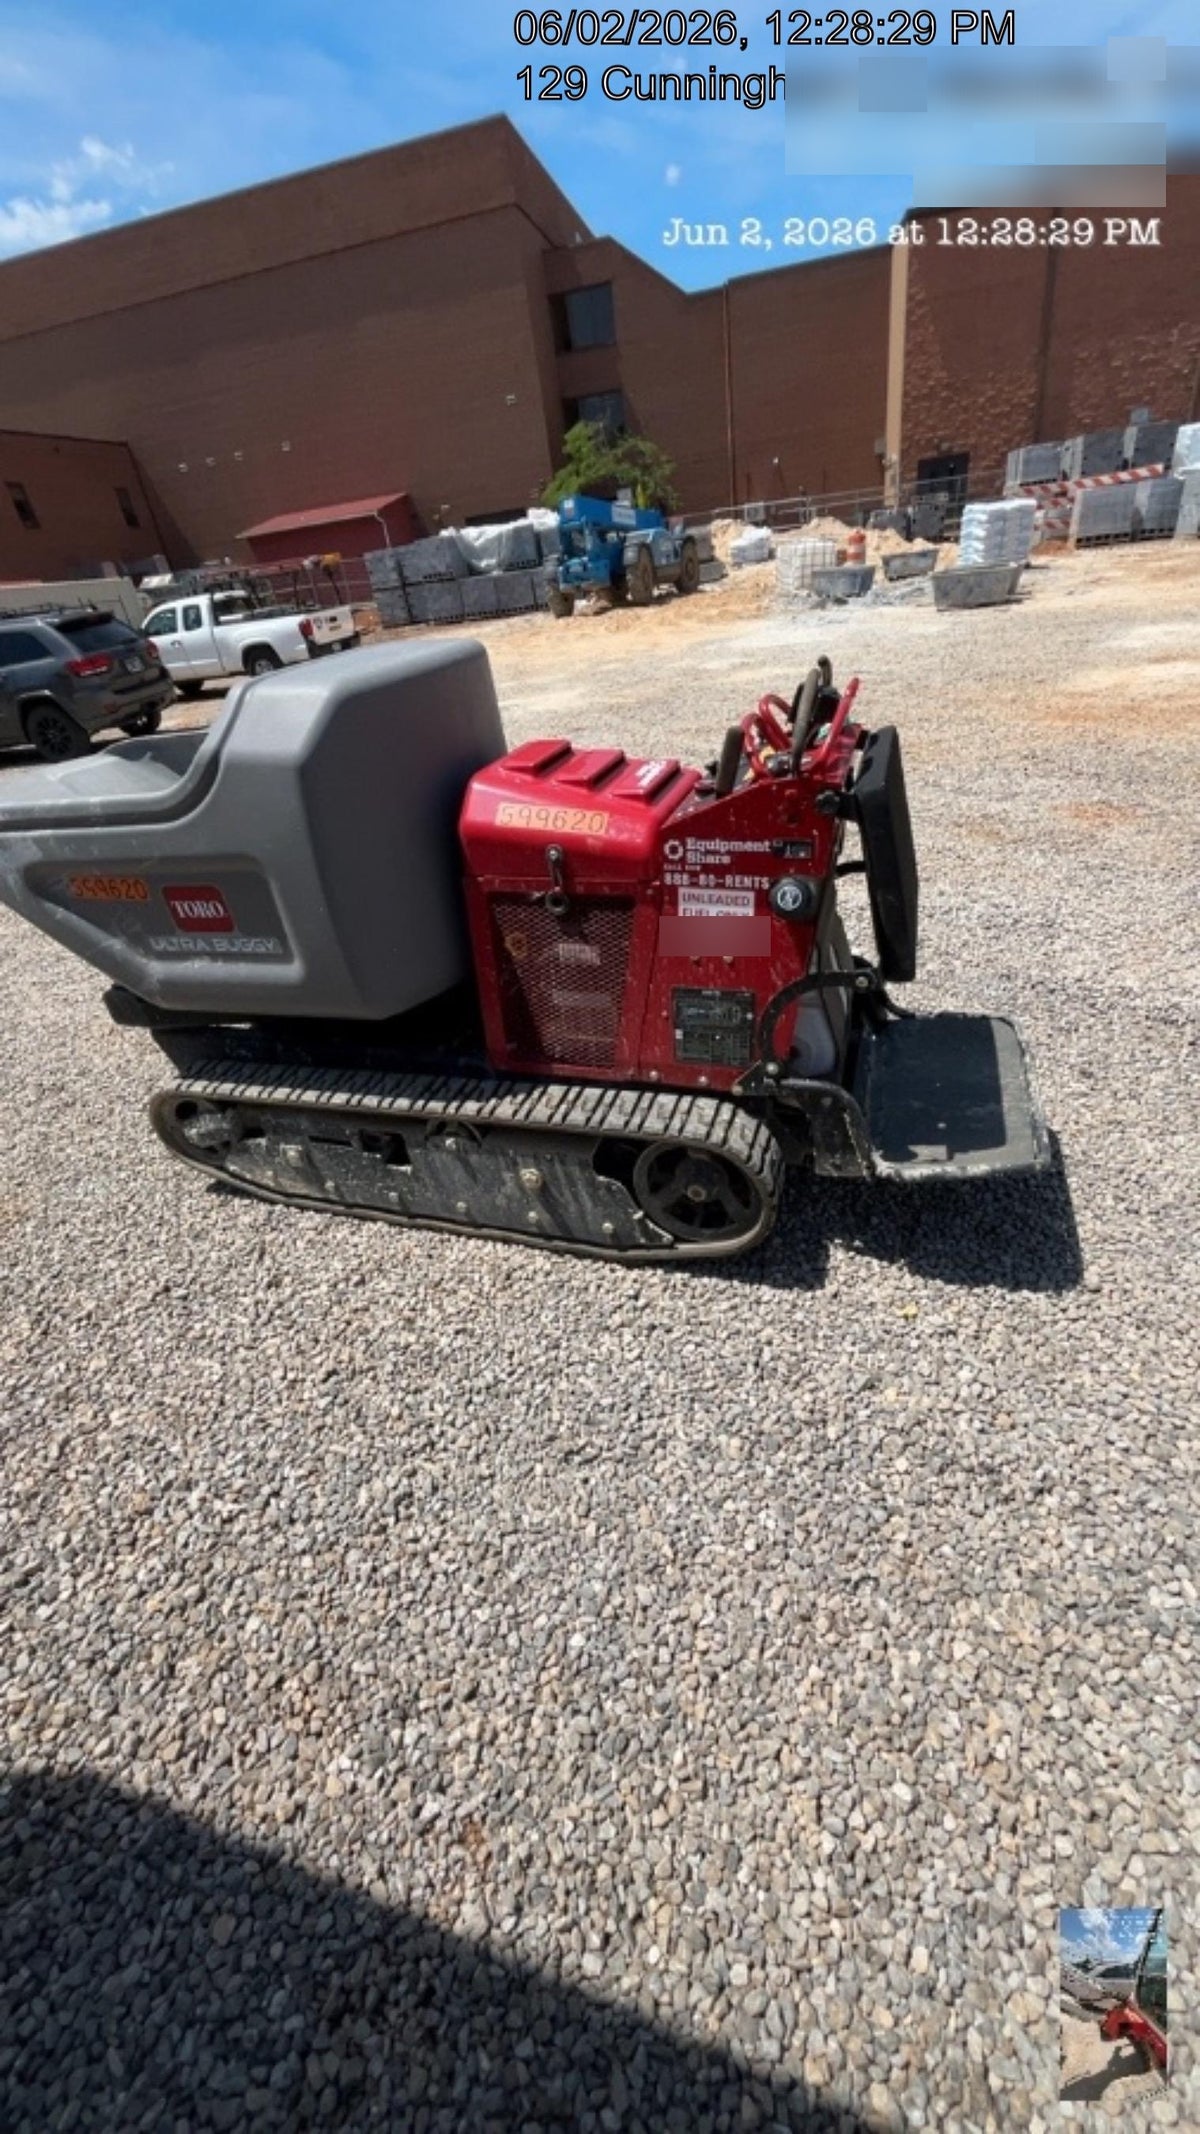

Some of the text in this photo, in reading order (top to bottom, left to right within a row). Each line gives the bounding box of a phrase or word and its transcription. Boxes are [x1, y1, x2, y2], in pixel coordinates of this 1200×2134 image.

[501, 805, 605, 833] 599620
[685, 837, 771, 853] Equipment
[686, 850, 731, 864] Share
[663, 872, 770, 890] 888-80-RENTS
[682, 892, 751, 906] UNLEADED
[170, 901, 225, 918] TORO
[150, 937, 275, 952] ULTRA BUGGY
